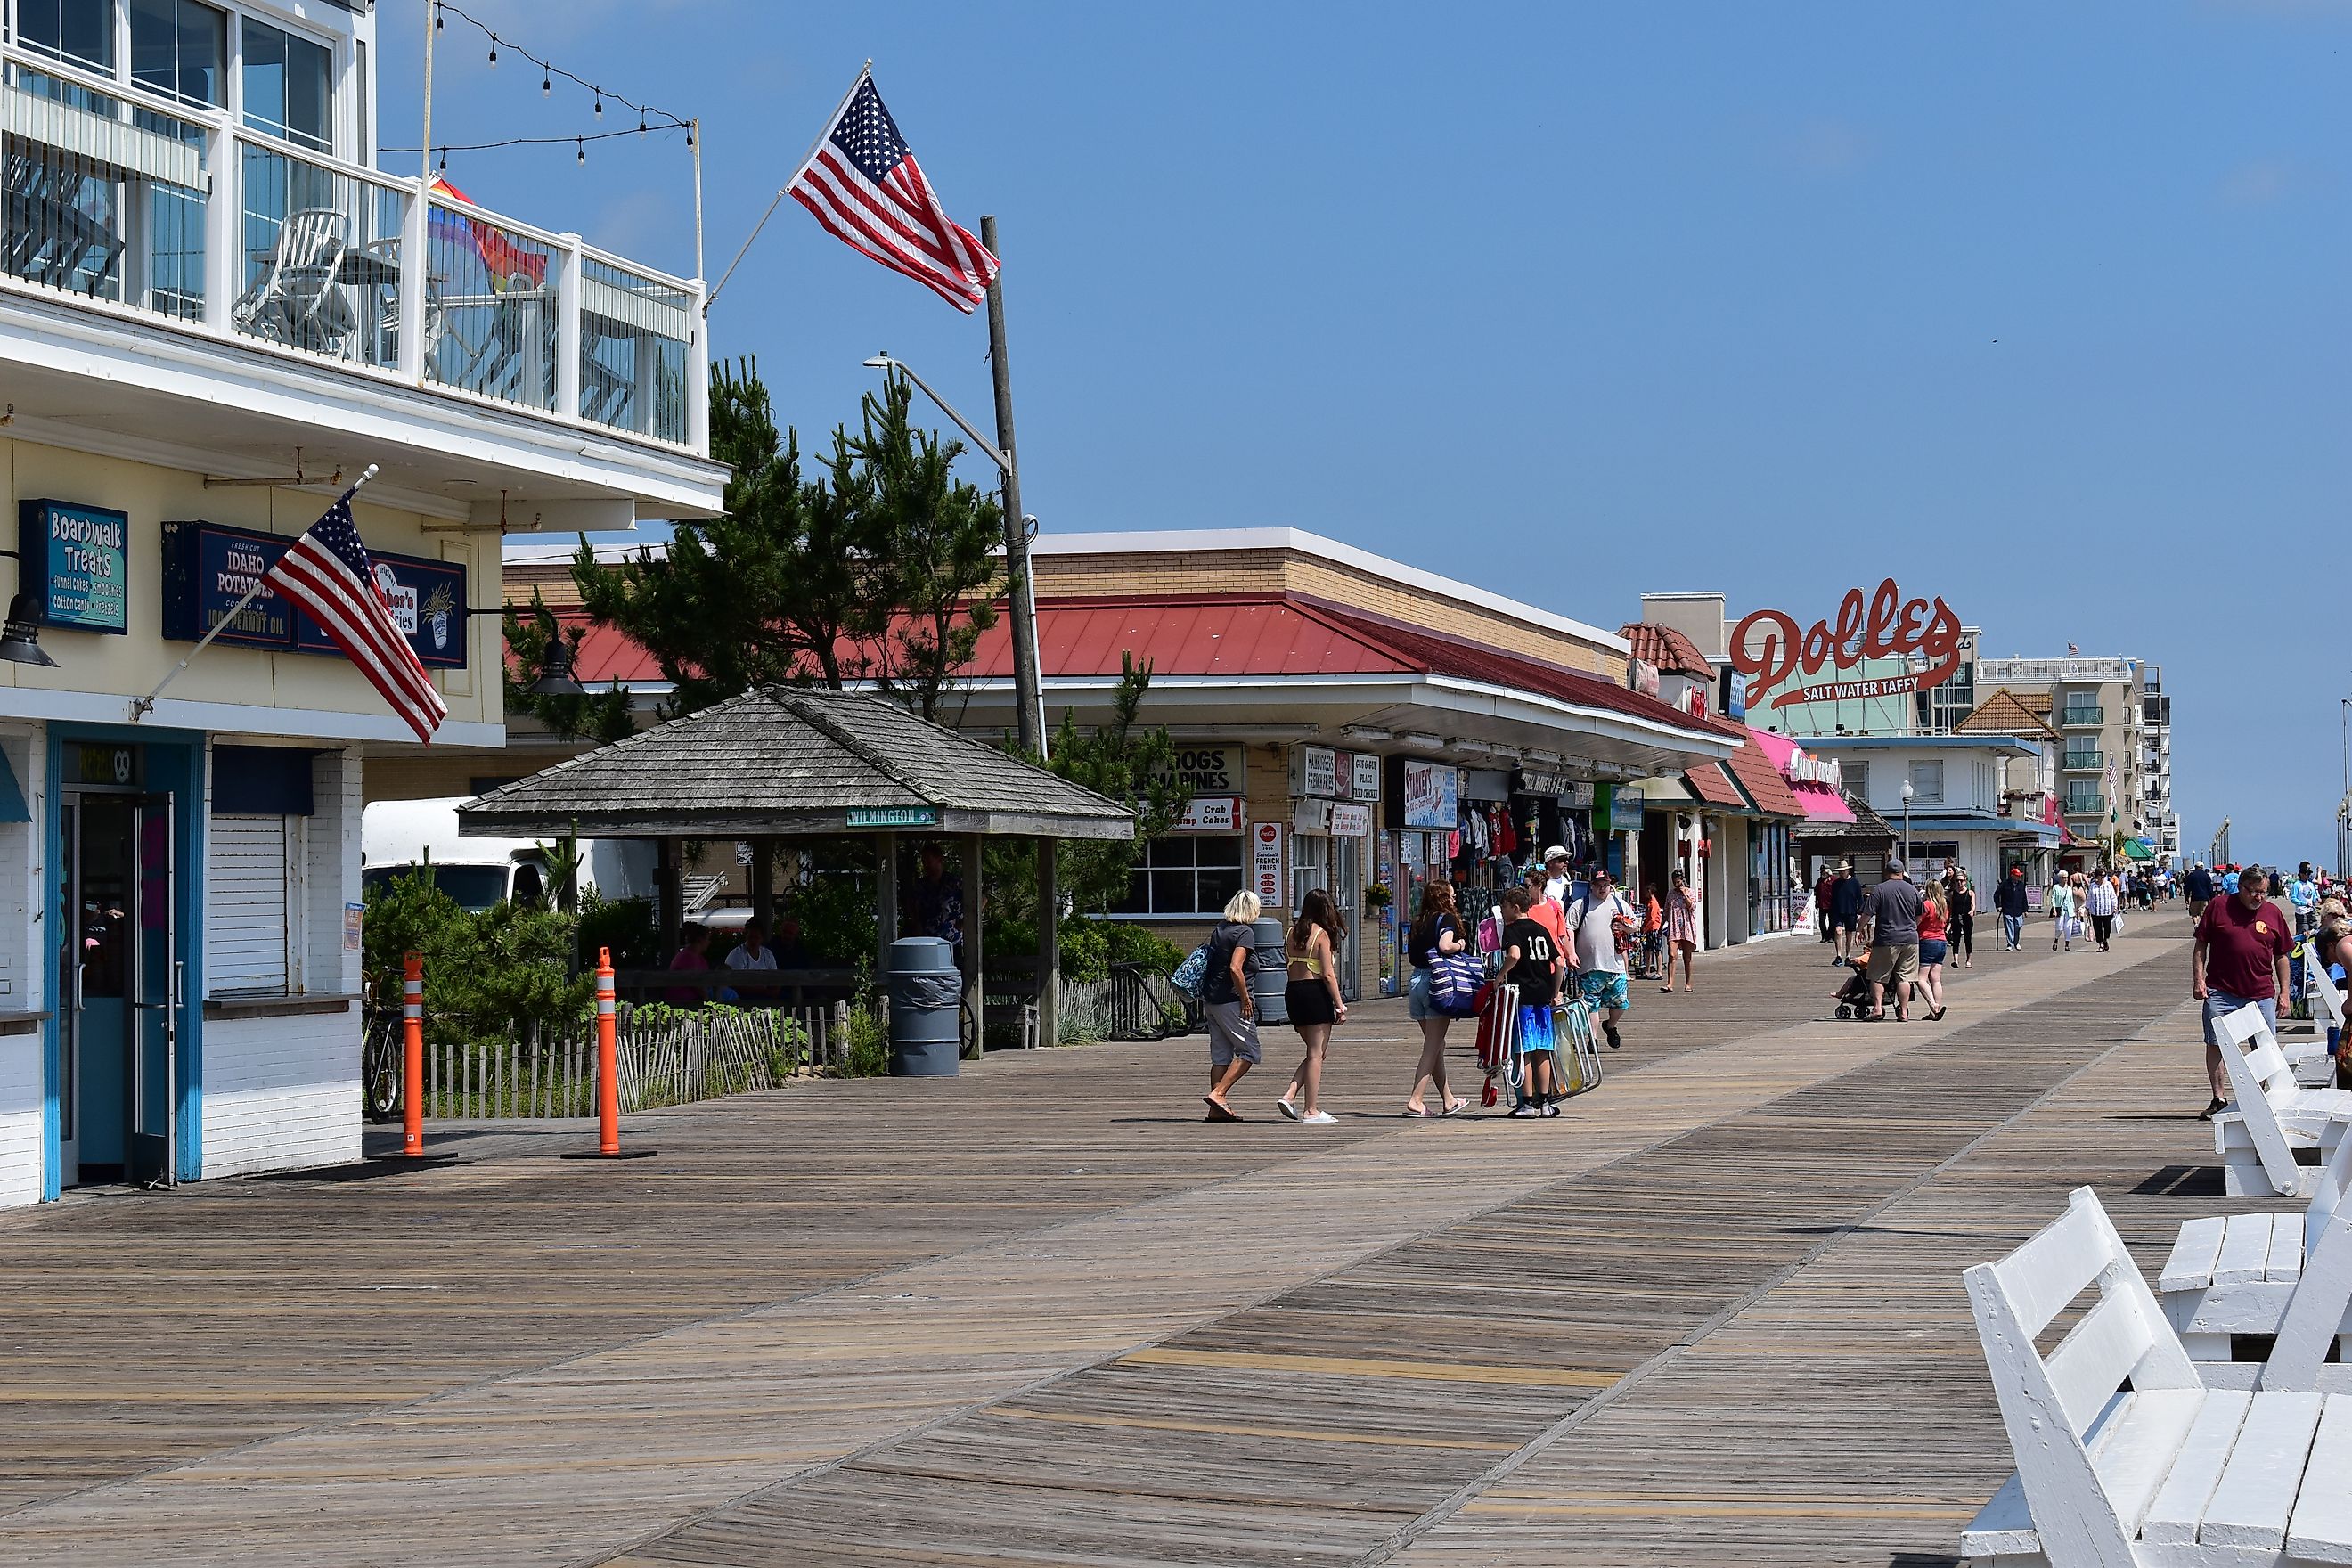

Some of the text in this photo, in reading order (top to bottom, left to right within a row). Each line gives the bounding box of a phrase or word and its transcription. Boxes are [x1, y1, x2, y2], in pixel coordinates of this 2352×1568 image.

[231, 542, 260, 552] FRESH CUT
[64, 546, 110, 577] Treats
[227, 551, 265, 574] IDAHO
[270, 617, 285, 635] OIL
[1803, 677, 1920, 701] SALT WATER TAFFY
[1308, 753, 1334, 772] HAMBURGERS
[1308, 772, 1334, 791] FRENCH FRIES
[1360, 773, 1373, 784] PLACE
[851, 809, 915, 823] WILMINGTON
[1204, 804, 1227, 814] Crab
[1202, 815, 1229, 824] Cakes
[1256, 857, 1280, 865] FRENCH
[1528, 936, 1550, 960] 10
